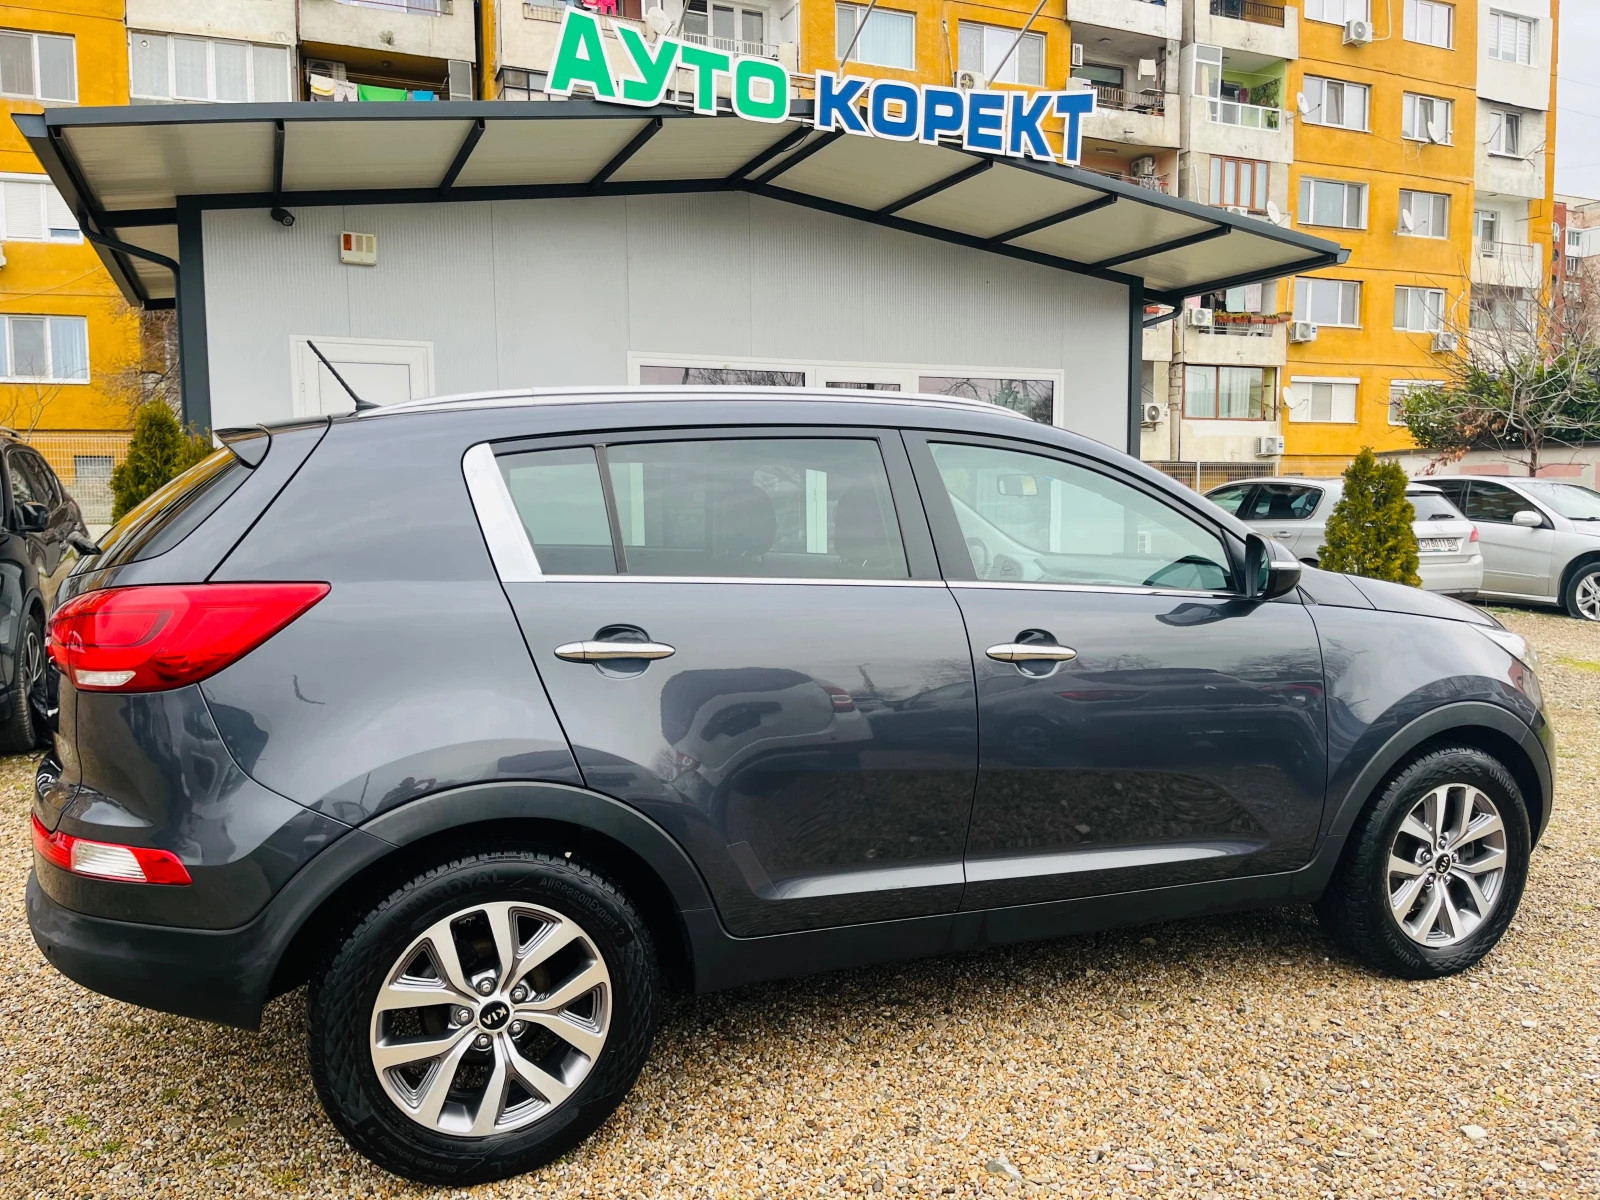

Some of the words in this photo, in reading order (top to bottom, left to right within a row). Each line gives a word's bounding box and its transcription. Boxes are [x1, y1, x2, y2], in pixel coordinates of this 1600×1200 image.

[546, 7, 789, 122] АУТО
[815, 72, 1096, 165] КОРЕКТ
[1438, 856, 1449, 872] KIA
[615, 928, 625, 939] 2
[481, 1006, 508, 1025] KIA
